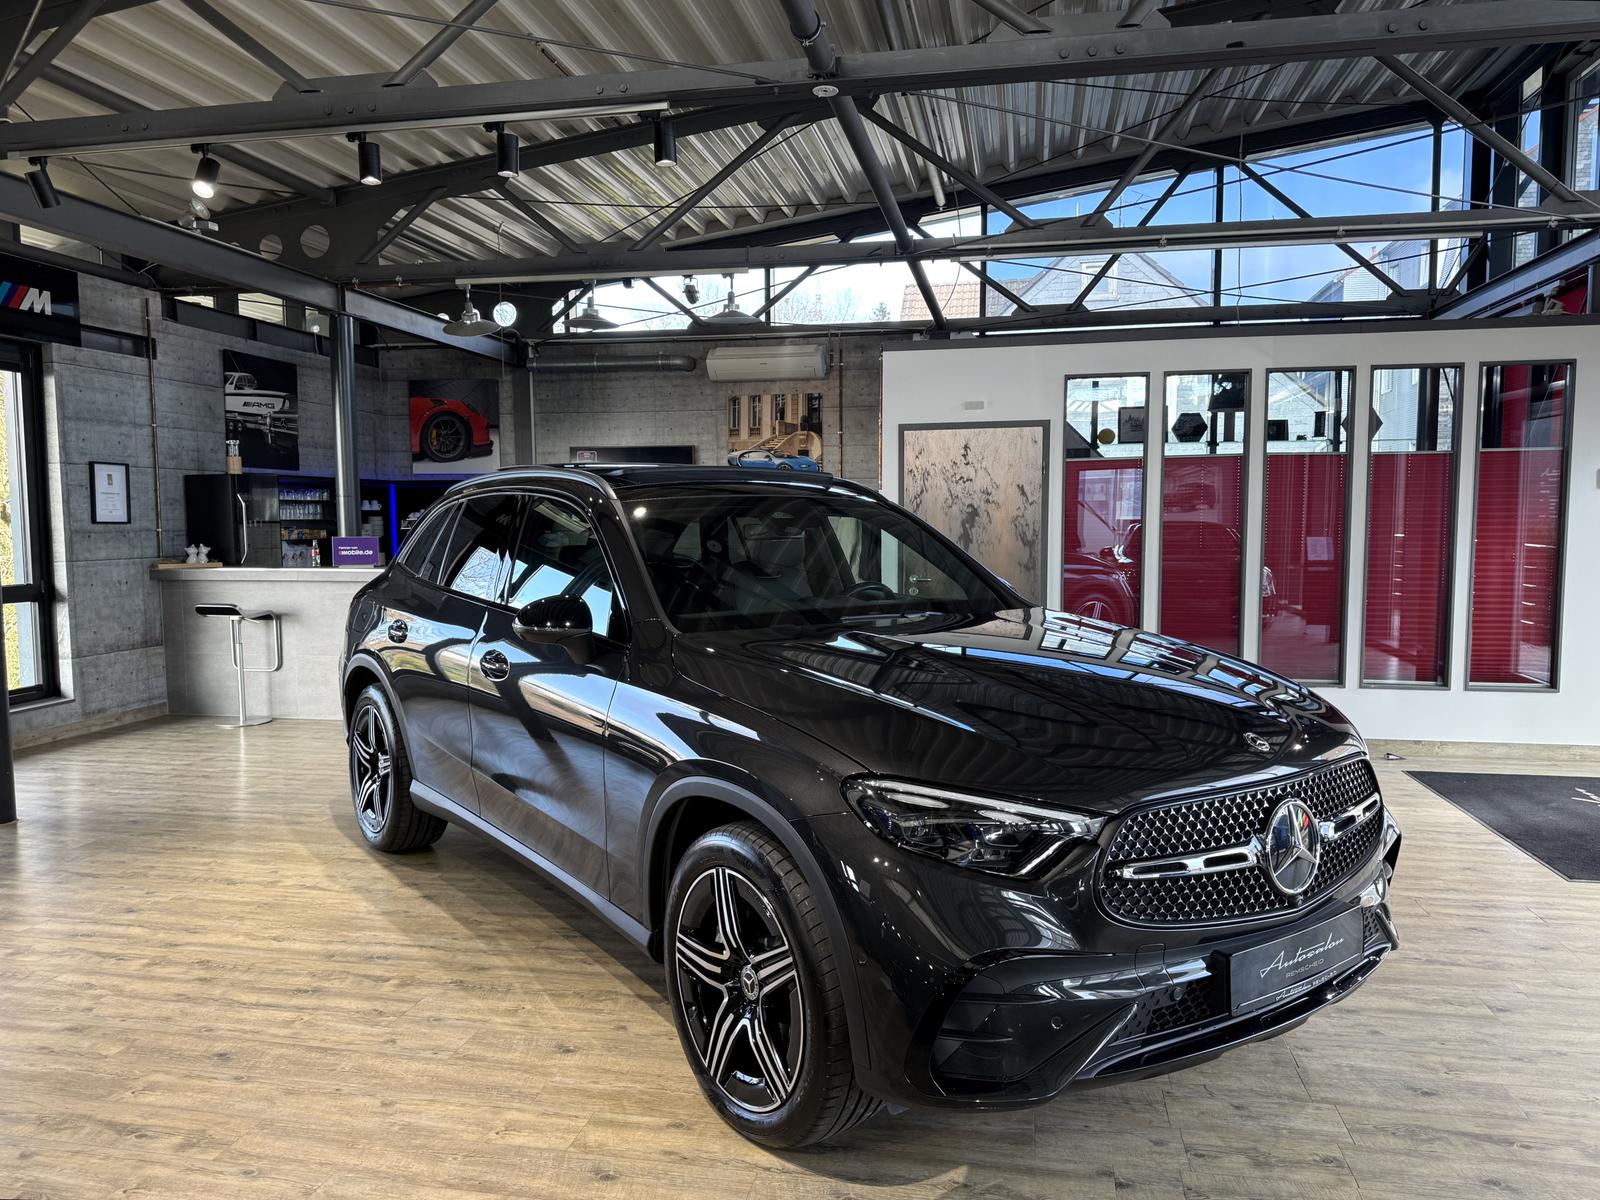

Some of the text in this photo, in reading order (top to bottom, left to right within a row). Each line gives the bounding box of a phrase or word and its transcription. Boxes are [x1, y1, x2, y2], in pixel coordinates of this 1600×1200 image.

[19, 287, 52, 316] M
[252, 401, 275, 410] AMG
[1259, 932, 1344, 979] Autosalon
[1285, 958, 1325, 978] REMSCHEID
